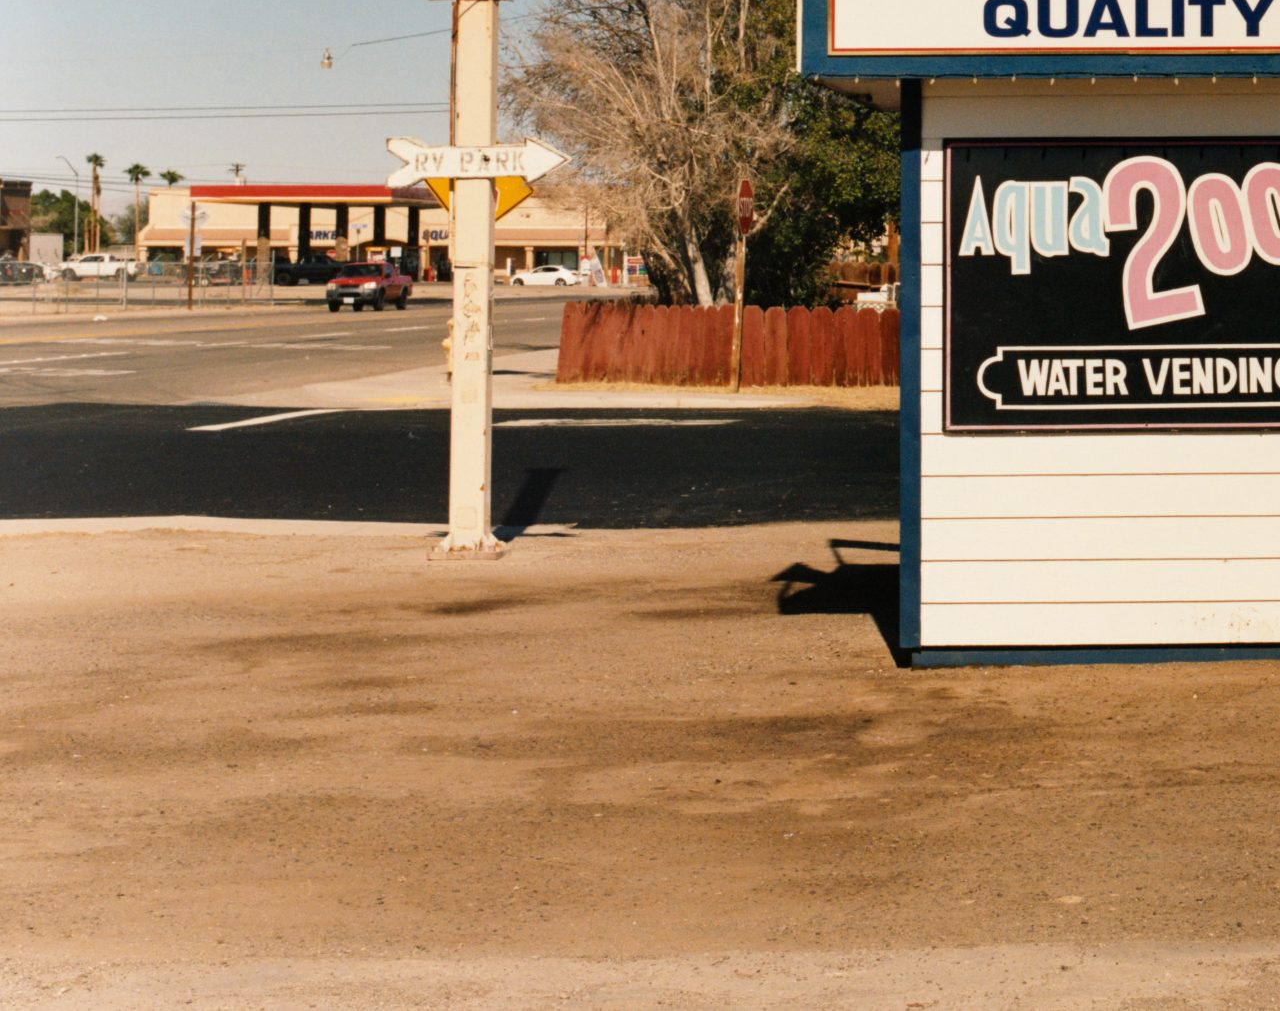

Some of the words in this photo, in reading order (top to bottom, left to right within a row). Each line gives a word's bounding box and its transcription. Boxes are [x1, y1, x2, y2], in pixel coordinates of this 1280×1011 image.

[415, 153, 444, 172] RV
[460, 151, 525, 172] PARK
[740, 197, 752, 217] STOP
[1017, 359, 1129, 396] WATER
